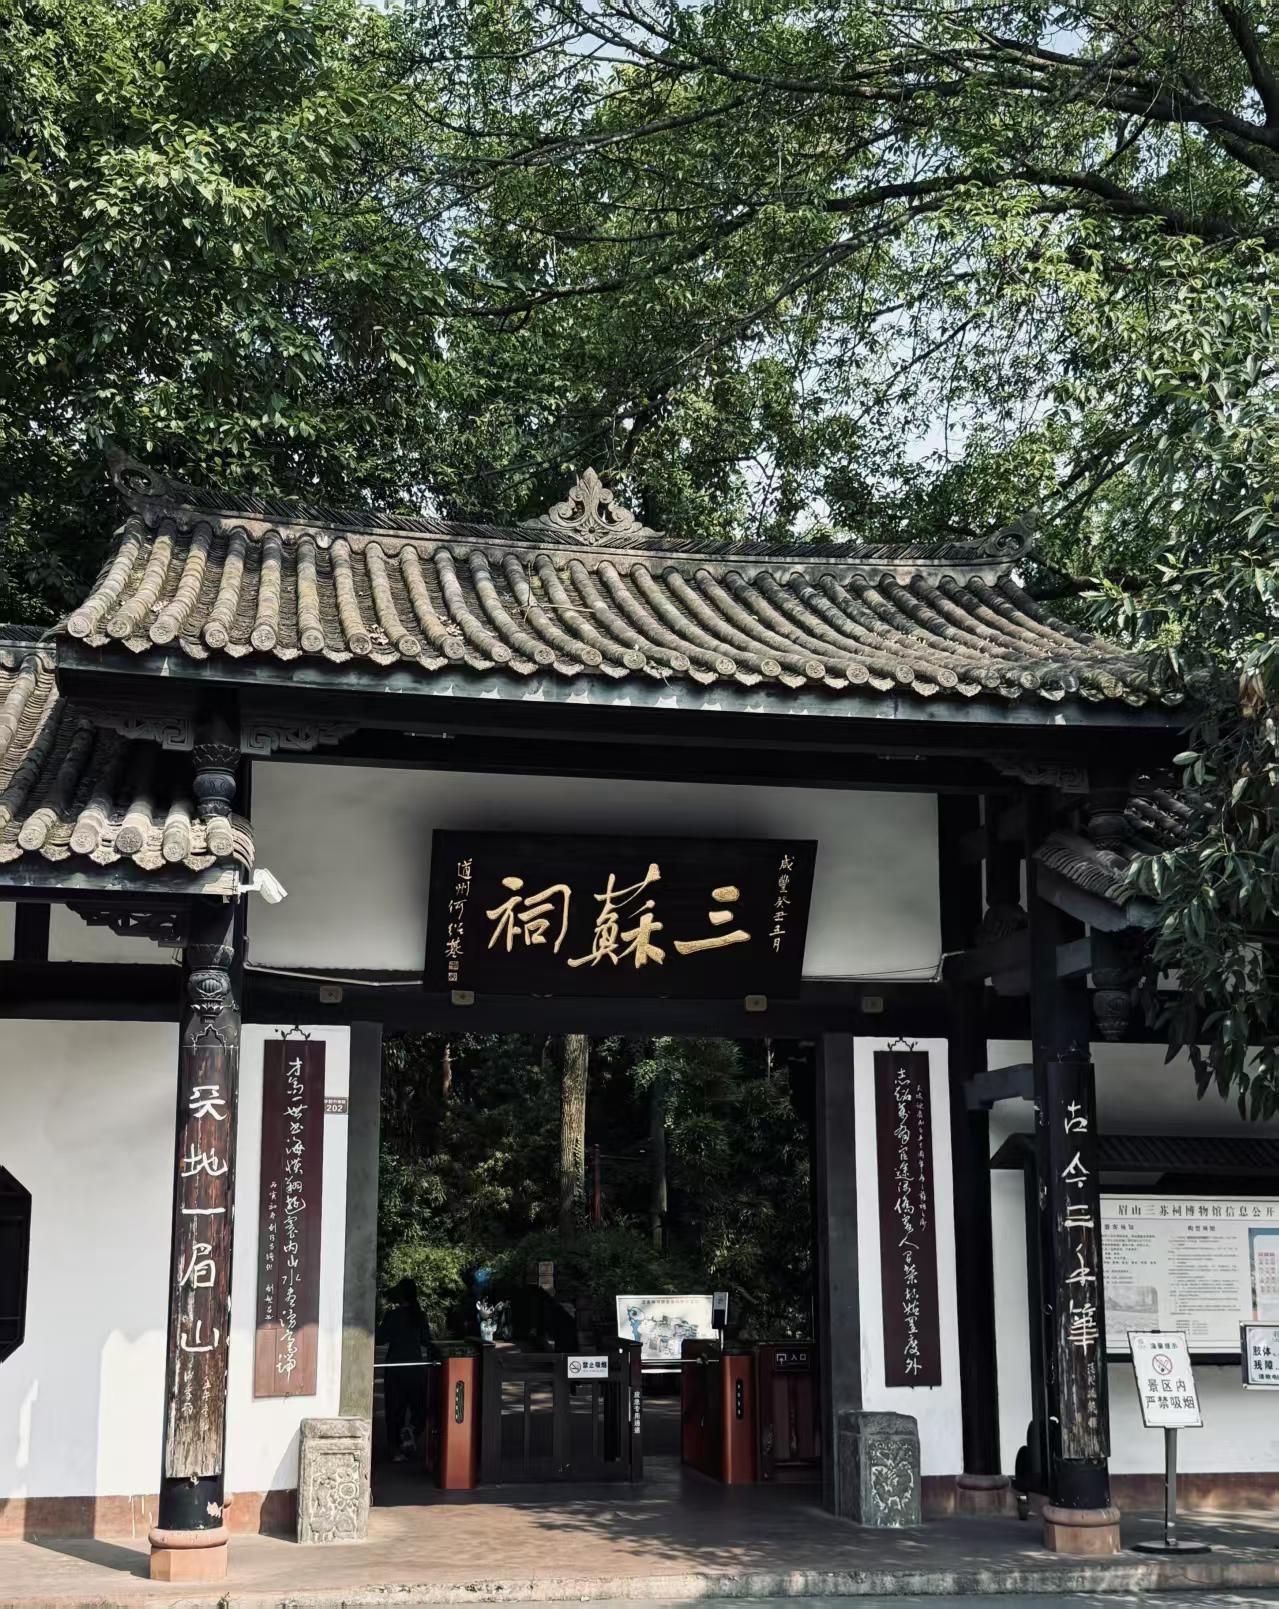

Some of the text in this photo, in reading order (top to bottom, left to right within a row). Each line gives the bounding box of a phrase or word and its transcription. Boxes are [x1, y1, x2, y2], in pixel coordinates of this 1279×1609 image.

[326, 1104, 343, 1112] 202
[1148, 1378, 1186, 1392] 景区内
[1145, 1395, 1195, 1409] 严禁吸烟
